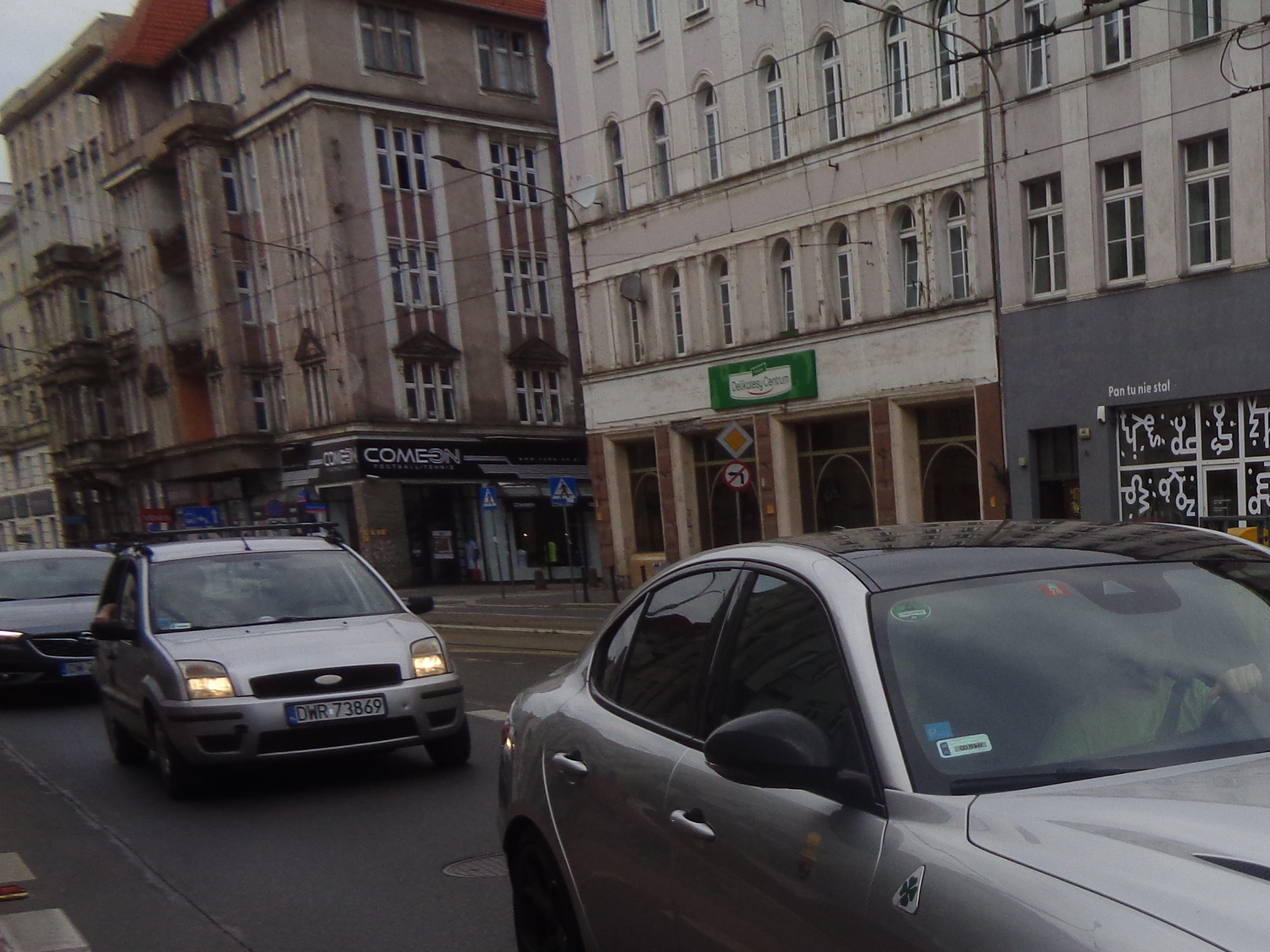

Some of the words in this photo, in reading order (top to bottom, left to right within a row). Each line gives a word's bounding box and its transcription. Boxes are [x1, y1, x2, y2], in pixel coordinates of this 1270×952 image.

[732, 379, 763, 391] Delikatesy
[763, 375, 789, 387] Centrum
[1108, 386, 1125, 397] Pan
[1127, 384, 1136, 396] tu
[1138, 382, 1152, 395] nie
[364, 447, 461, 465] COMEON
[296, 704, 328, 721] DWR
[331, 698, 383, 719] 73869
